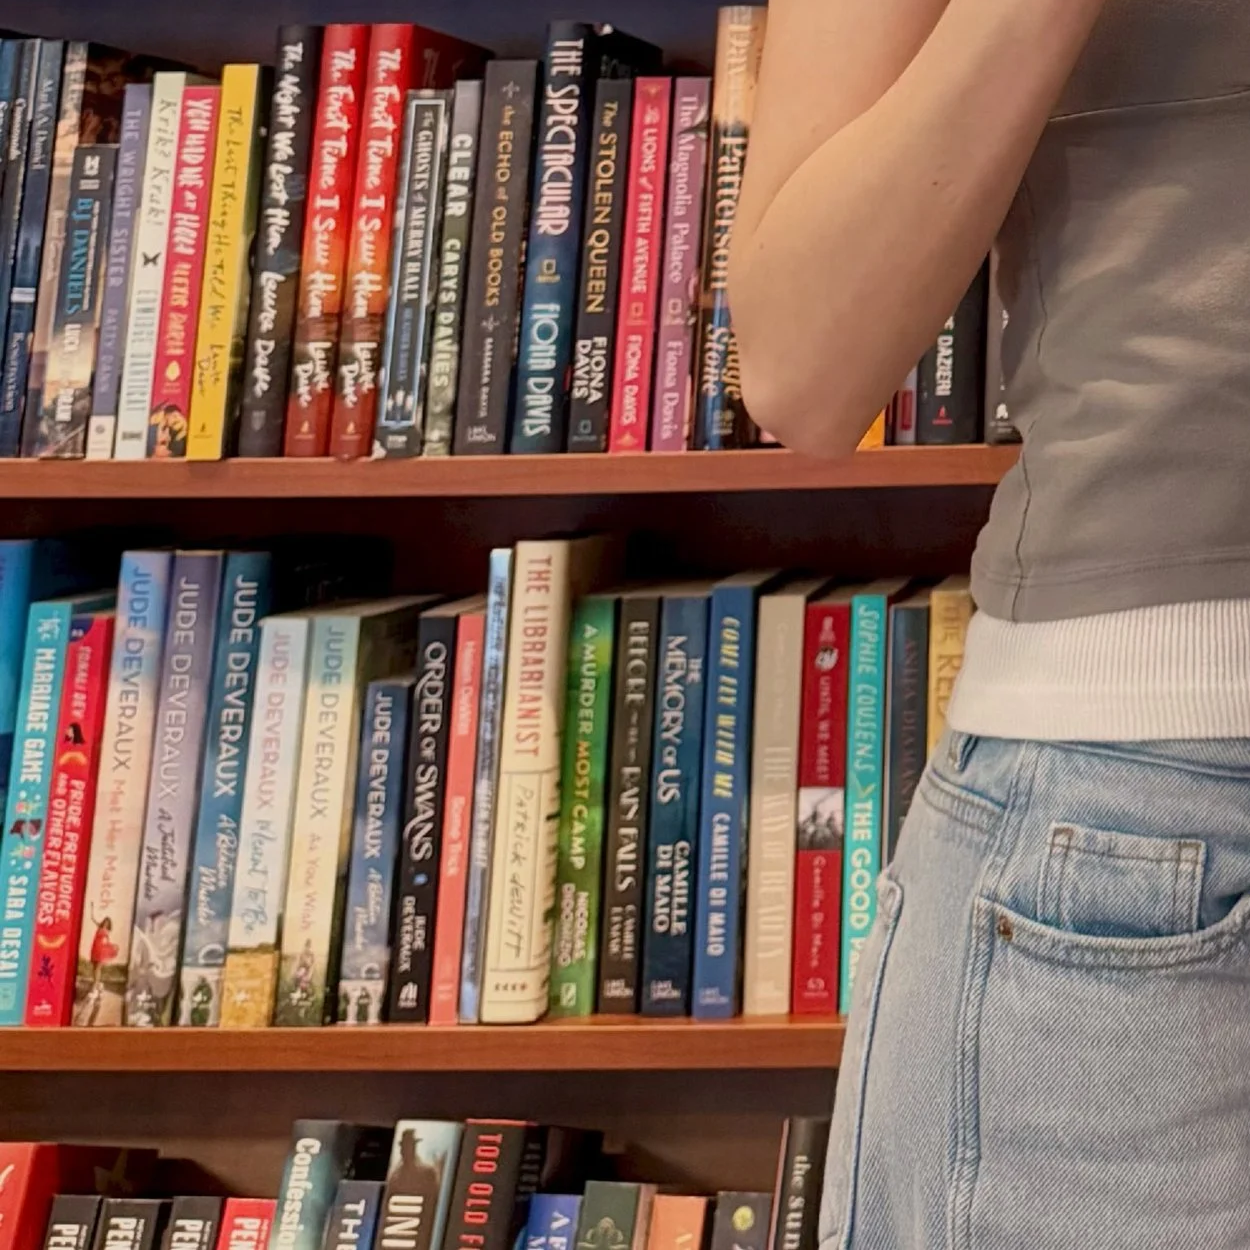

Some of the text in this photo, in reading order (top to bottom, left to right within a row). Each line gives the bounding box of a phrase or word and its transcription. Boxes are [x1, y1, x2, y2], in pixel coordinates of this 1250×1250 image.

[536, 39, 584, 236] THE SPECTACULAR
[585, 134, 618, 314] STOLEN QUEEN
[433, 133, 472, 387] CLEAR CARYS DAVIES
[213, 576, 258, 798] JUDE DEVERAUX
[516, 557, 552, 757] THE LIBRARIANIST
[464, 1133, 503, 1225] TOO OLD
